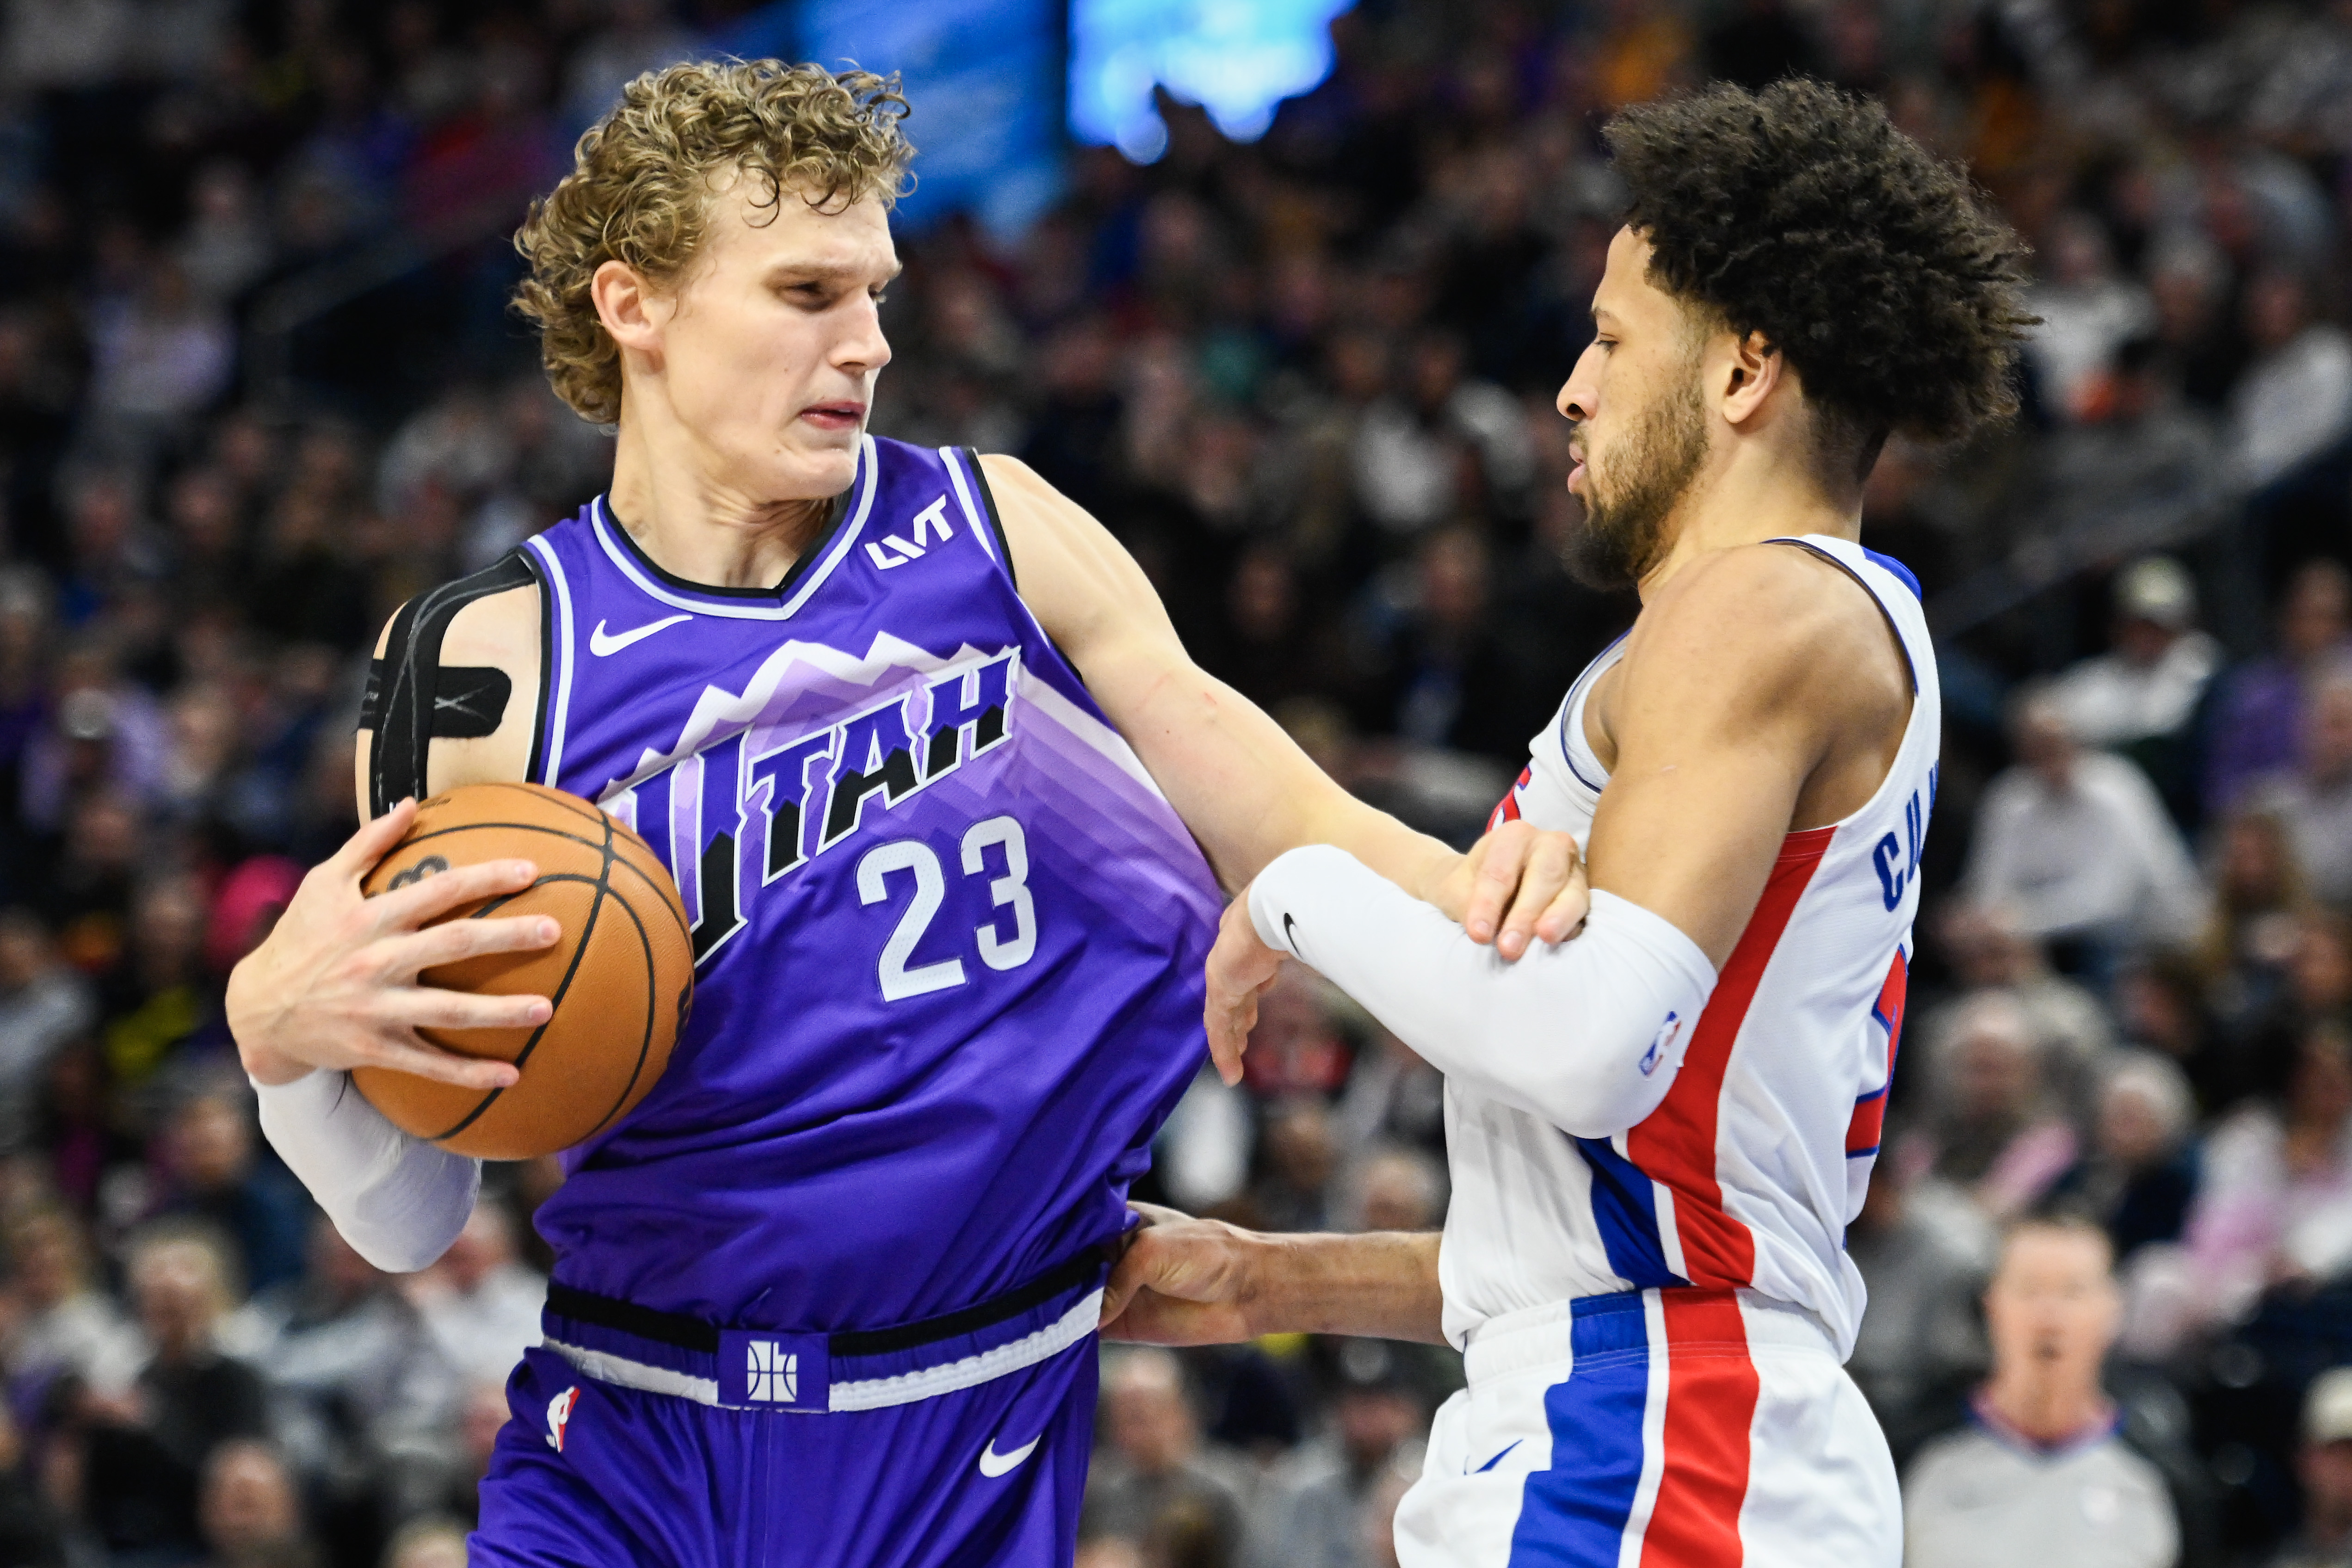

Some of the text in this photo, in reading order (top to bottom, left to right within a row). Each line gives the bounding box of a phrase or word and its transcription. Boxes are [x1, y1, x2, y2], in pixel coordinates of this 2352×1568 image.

[864, 494, 953, 570] LVT
[627, 645, 1021, 969] UTAH
[856, 815, 1037, 1002] 23
